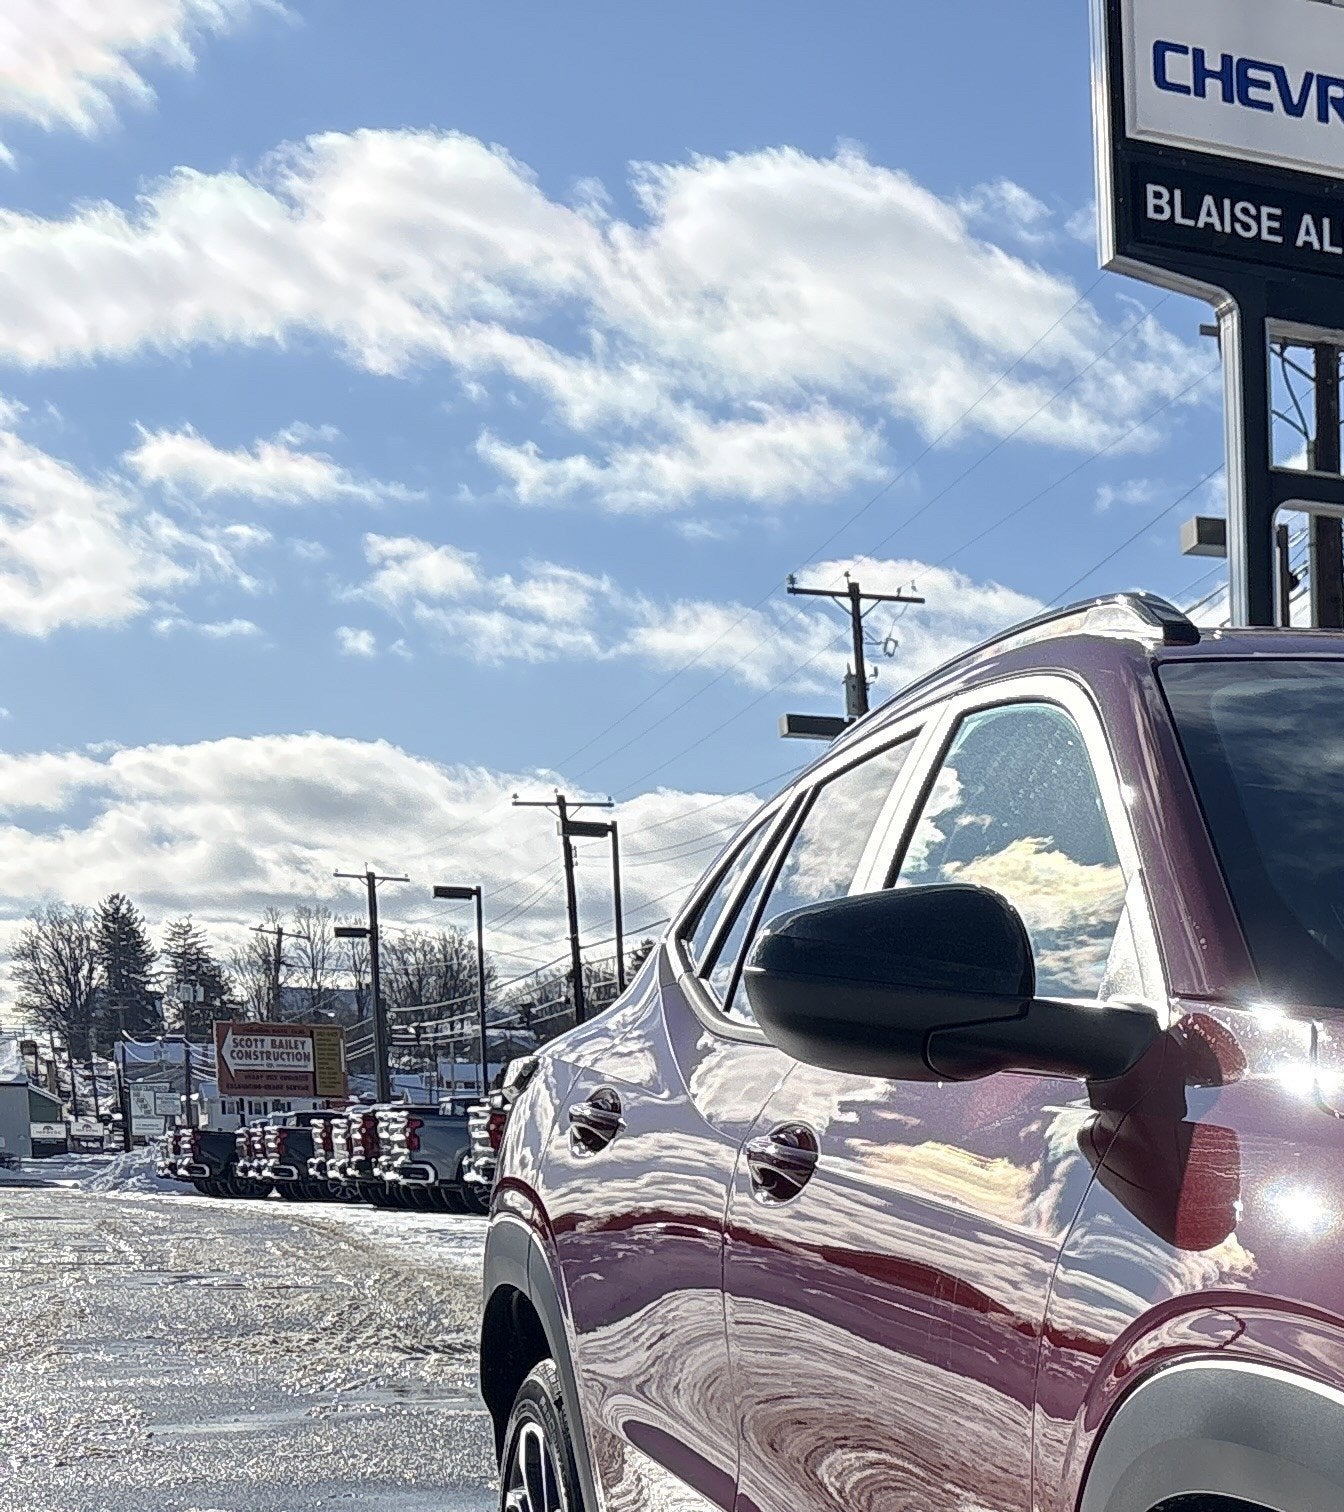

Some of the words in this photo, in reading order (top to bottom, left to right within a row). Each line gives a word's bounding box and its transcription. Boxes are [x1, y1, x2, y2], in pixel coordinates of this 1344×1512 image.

[1145, 183, 1283, 244] BLAISE
[232, 1037, 265, 1049] SCOTT
[270, 1038, 306, 1050] BAILEY
[230, 1049, 311, 1062] CONSTRUCTION
